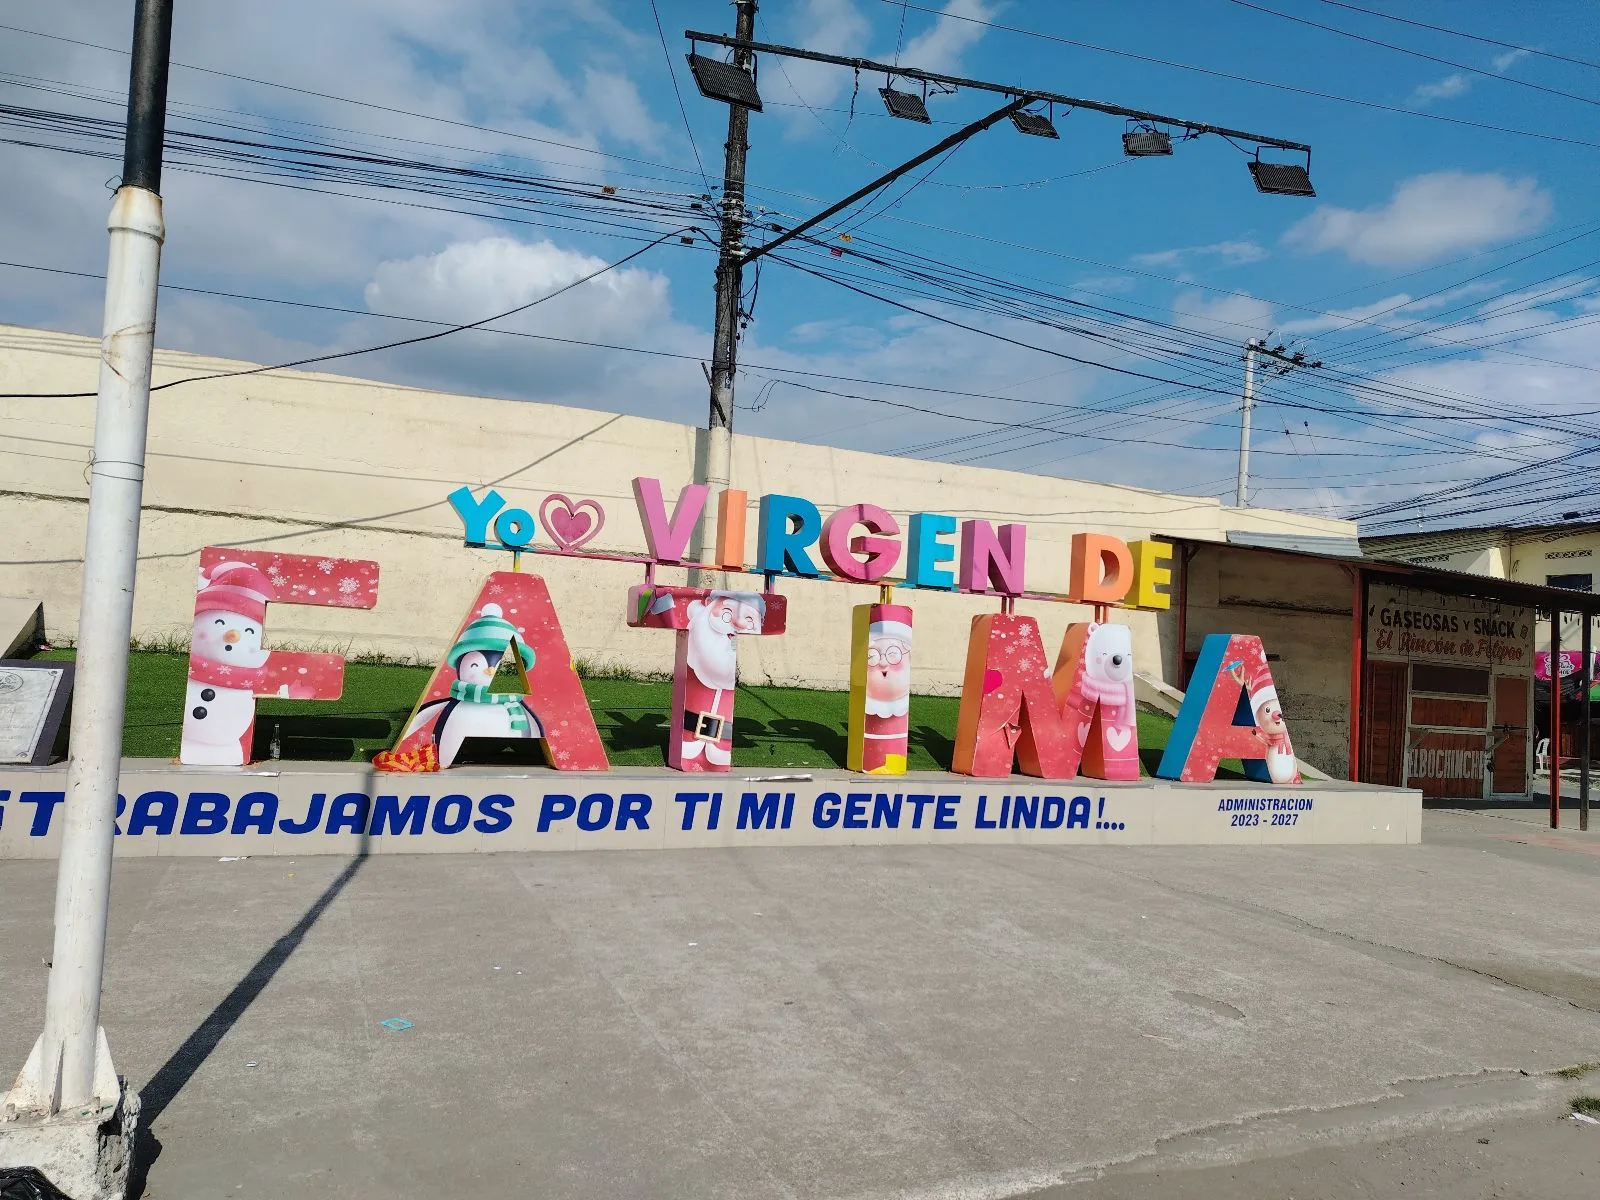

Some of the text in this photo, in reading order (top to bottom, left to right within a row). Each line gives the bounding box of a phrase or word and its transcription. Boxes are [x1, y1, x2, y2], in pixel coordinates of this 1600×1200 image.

[447, 476, 1173, 609] Yo VIRGEN DE
[1380, 607, 1459, 633] GASEOSAS
[1474, 617, 1516, 639] SNACK
[1460, 639, 1475, 657] de
[179, 545, 1302, 785] FATIMA
[0, 791, 514, 836] TABAJAMOS
[538, 794, 652, 832] POR
[676, 793, 721, 830] TI
[737, 793, 794, 829] MI
[813, 793, 960, 829] GENTE
[1218, 799, 1313, 812] ADMINISTRACION
[1231, 814, 1259, 827] 2023
[1271, 813, 1298, 826] 2027
